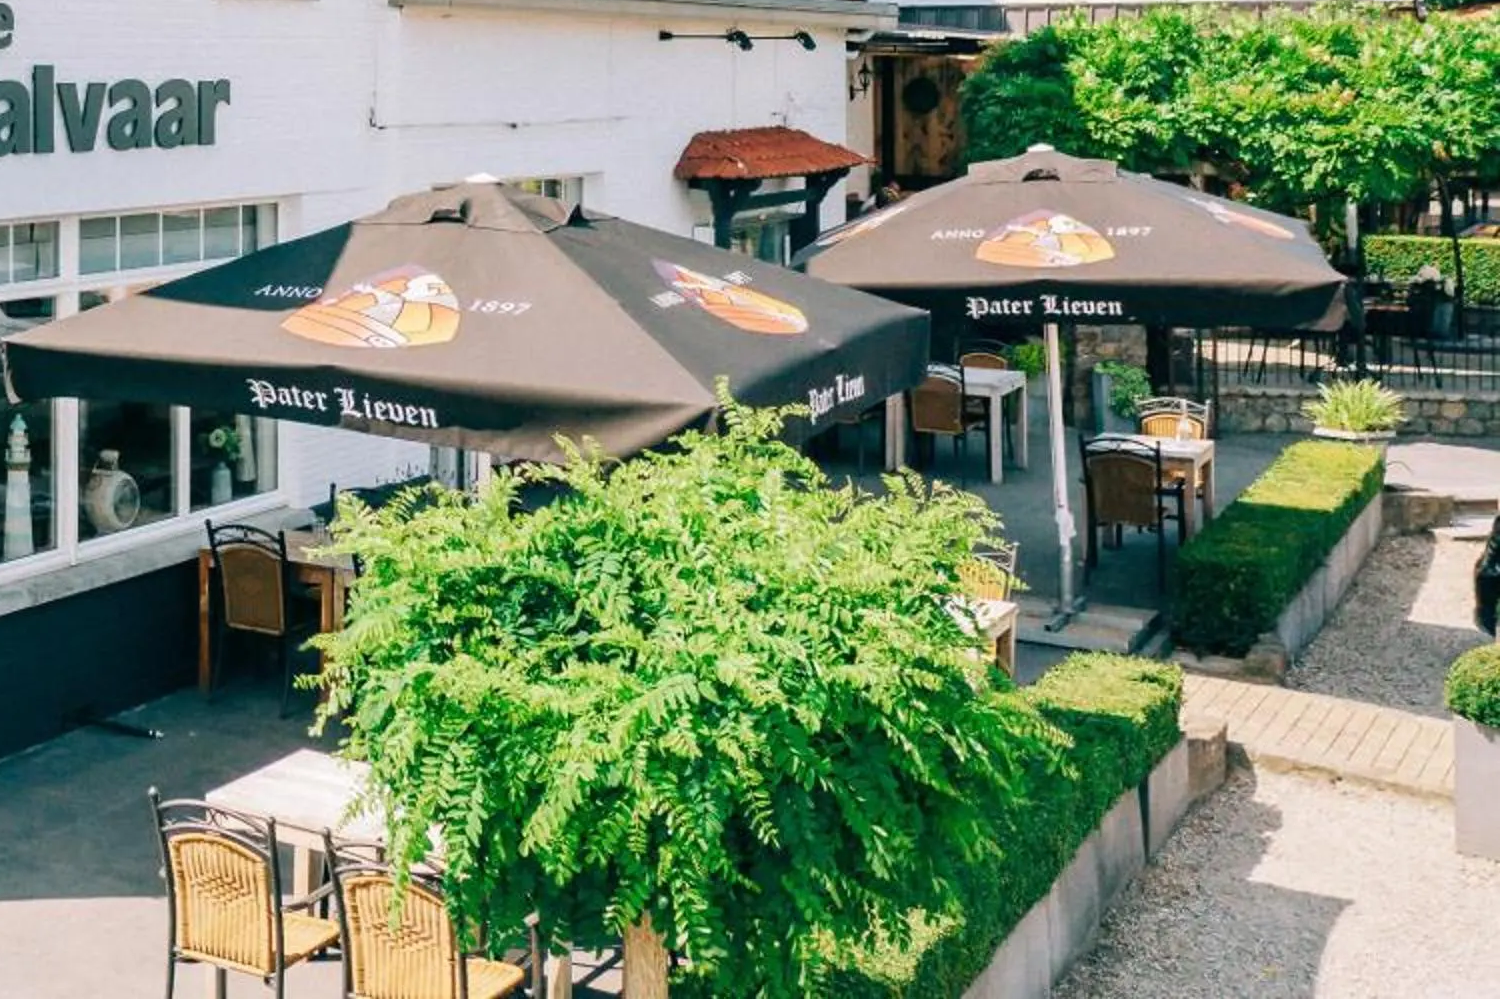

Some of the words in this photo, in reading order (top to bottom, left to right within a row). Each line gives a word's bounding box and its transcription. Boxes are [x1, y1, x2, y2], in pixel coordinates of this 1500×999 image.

[930, 229, 985, 240] ANNO
[253, 284, 324, 300] ANNO
[467, 298, 532, 315] 1897
[965, 296, 1033, 320] Pater
[1040, 294, 1124, 316] Lieven
[245, 378, 329, 411] Pater
[334, 386, 440, 429] Lieven
